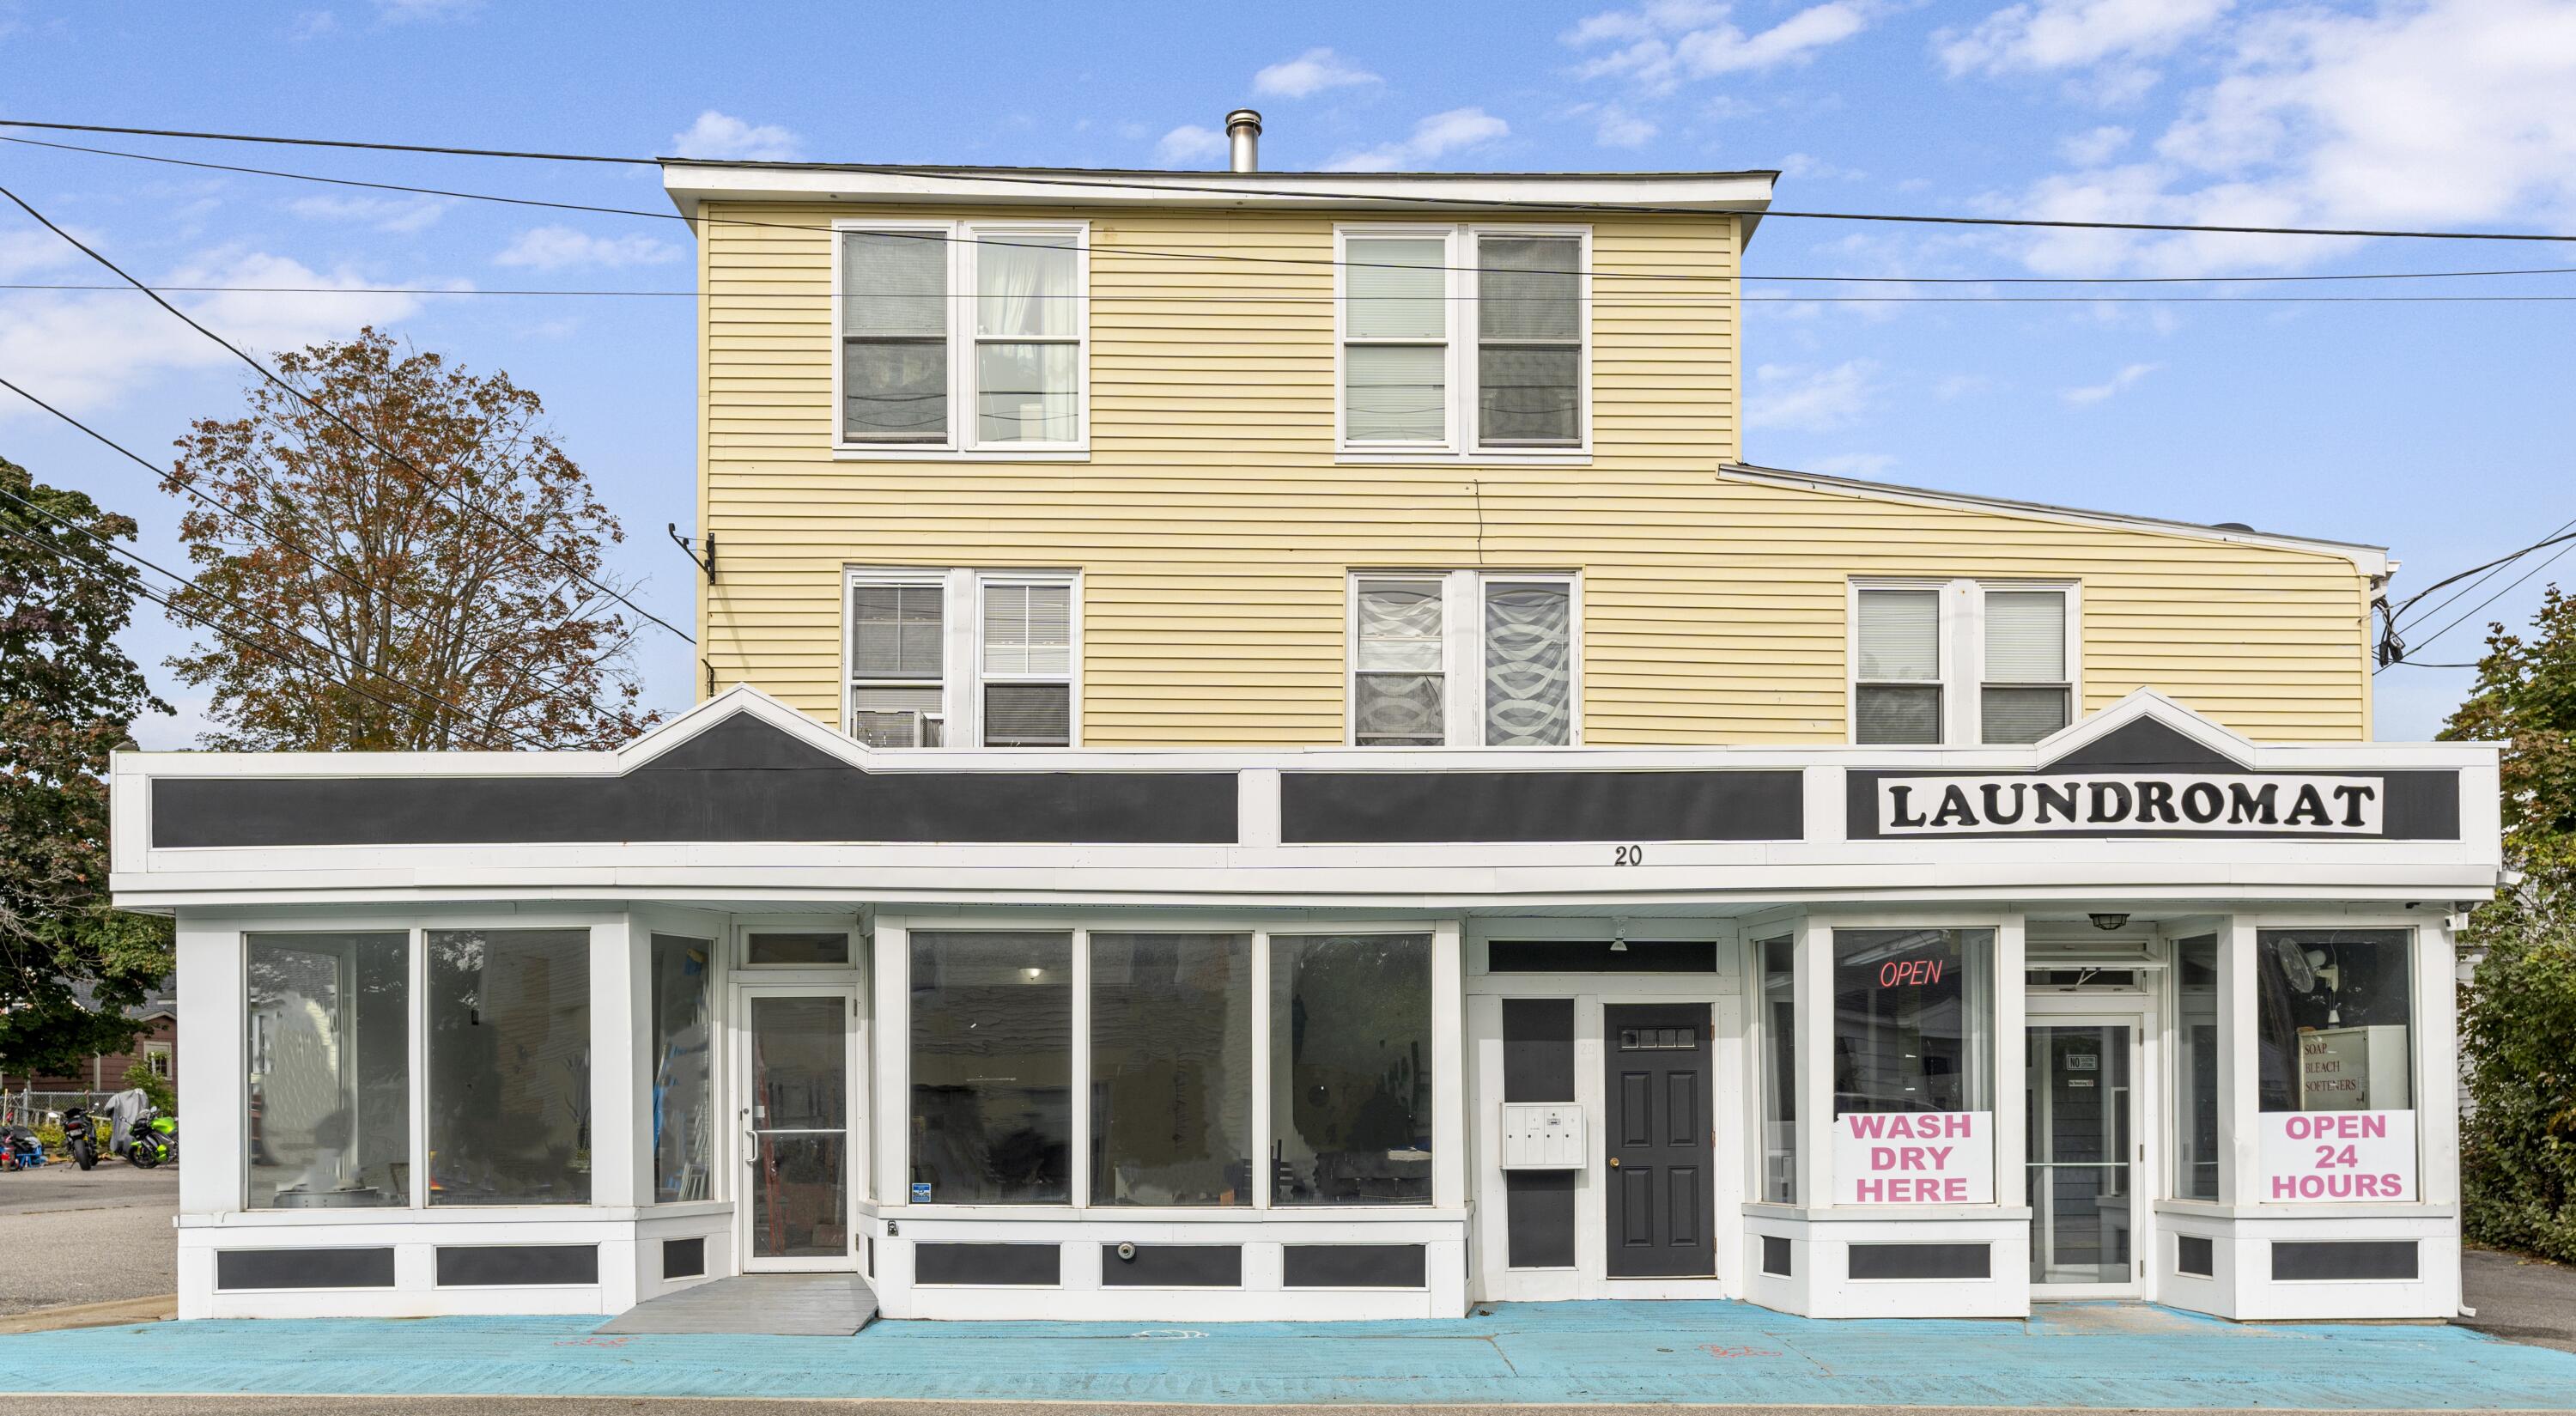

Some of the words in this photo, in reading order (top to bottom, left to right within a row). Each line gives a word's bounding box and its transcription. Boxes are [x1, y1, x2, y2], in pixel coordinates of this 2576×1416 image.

[1889, 781, 2375, 828] LAUNDROMAT
[1614, 844, 1643, 866] 20
[1880, 960, 1943, 988] OPEN
[2305, 1043, 2327, 1054] SOAP
[2069, 1057, 2080, 1067] NO
[2306, 1060, 2340, 1073] BLEACH
[2306, 1079, 2356, 1092] SOFTENERS
[1849, 1114, 1971, 1139] WASH
[2285, 1115, 2386, 1140] OPEN
[1871, 1146, 1953, 1170] DRY
[2315, 1145, 2358, 1169] 24
[1856, 1177, 1967, 1202] HERE
[2272, 1173, 2403, 1200] HOURS
